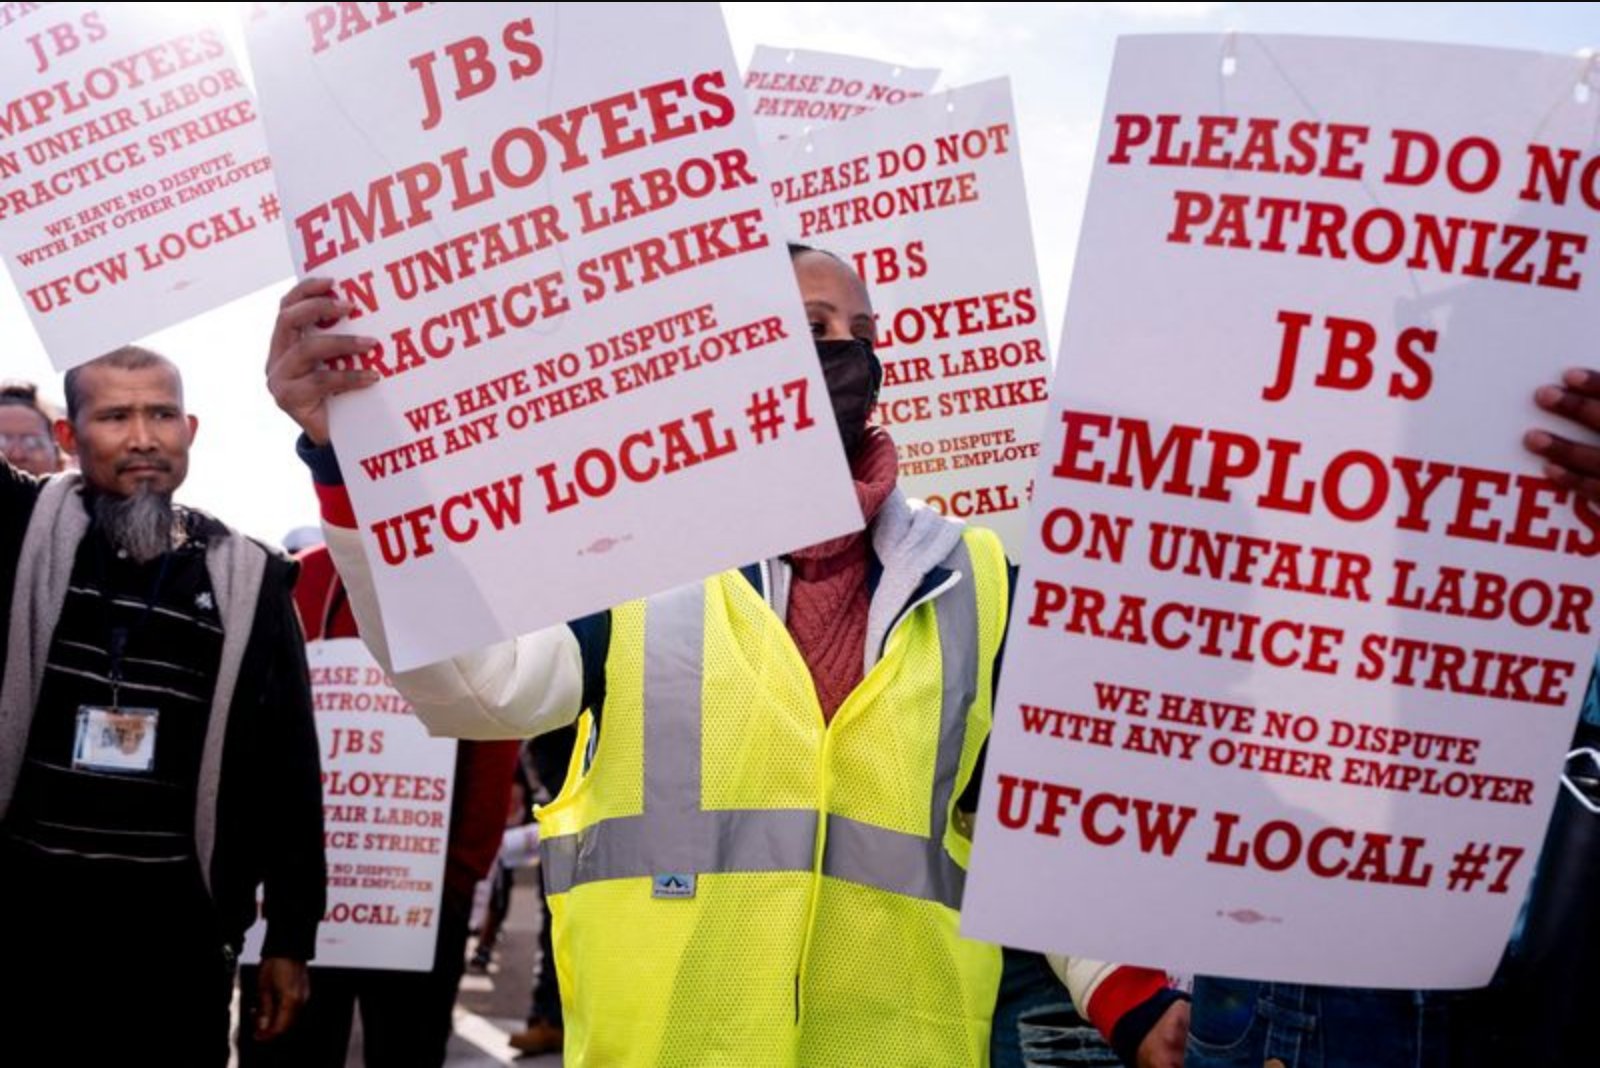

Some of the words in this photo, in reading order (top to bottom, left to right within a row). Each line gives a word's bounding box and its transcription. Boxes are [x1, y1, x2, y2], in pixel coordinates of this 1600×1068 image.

[25, 10, 108, 74] JBS
[409, 17, 544, 131] JBS
[24, 107, 140, 167] UNFAIR
[140, 67, 246, 122] LABOR
[148, 99, 258, 158] STRIKE
[744, 71, 824, 93] PLEASE
[825, 76, 863, 97] DO
[866, 83, 924, 105] NO
[44, 214, 76, 238] WE
[77, 197, 127, 227] HAVE
[128, 183, 158, 204] NO
[159, 152, 237, 194] DISPUTE
[296, 69, 738, 272] EMPLOYEES
[770, 156, 870, 206] PLEASE
[877, 143, 927, 179] DO
[935, 123, 1010, 166] NOT
[1108, 114, 1370, 180] PLEASE
[1384, 129, 1501, 194] DO
[17, 238, 69, 268] WITH
[73, 219, 110, 247] ANY
[112, 197, 177, 230] OTHER
[384, 203, 570, 302] UNFAIR
[580, 147, 759, 235] LABOR
[799, 172, 979, 238] PATRONIZE
[1167, 190, 1588, 291] PATRONIZE
[27, 252, 130, 315] UFCW
[134, 204, 258, 272] LOCAL
[578, 208, 770, 306] STRIKE
[404, 399, 452, 432] WE
[455, 371, 532, 417] HAVE
[537, 353, 581, 387] NO
[589, 304, 718, 370] DISPUTE
[883, 358, 935, 387] AIR
[940, 338, 1046, 379] LABOR
[1262, 310, 1439, 402] JBS
[361, 442, 439, 482] WITH
[443, 418, 501, 460] ANY
[511, 382, 611, 430] OTHER
[613, 316, 789, 394] EMPLOYER
[866, 397, 932, 426] ICE
[939, 377, 1049, 417] STRIKE
[372, 474, 526, 568] UFCW
[536, 408, 738, 515] LOCAL
[744, 378, 817, 446] #7
[896, 457, 948, 477] THER
[906, 441, 934, 459] NO
[938, 428, 1017, 453] DISPUTE
[1041, 507, 1133, 563] ON
[1148, 522, 1372, 602] UNFAIR
[1386, 560, 1595, 635] LABOR
[1028, 580, 1345, 675] PRACTICE
[1356, 634, 1576, 707] STRIKE
[328, 729, 385, 760] JBS
[1018, 704, 1114, 746] WITH
[1121, 724, 1200, 762] ANY
[1208, 739, 1334, 781] OTHER
[1340, 763, 1536, 805] EMPLOYER
[1093, 682, 1152, 718] WE
[1159, 691, 1255, 735] HAVE
[1263, 711, 1319, 743] NO
[1329, 721, 1481, 765] DISPUTE
[363, 833, 440, 854] STRIKE
[372, 807, 444, 828] LABOR
[996, 774, 1197, 857] UFCW
[1206, 812, 1433, 888] LOCAL
[1446, 842, 1526, 894] #7
[406, 905, 434, 928] #7
